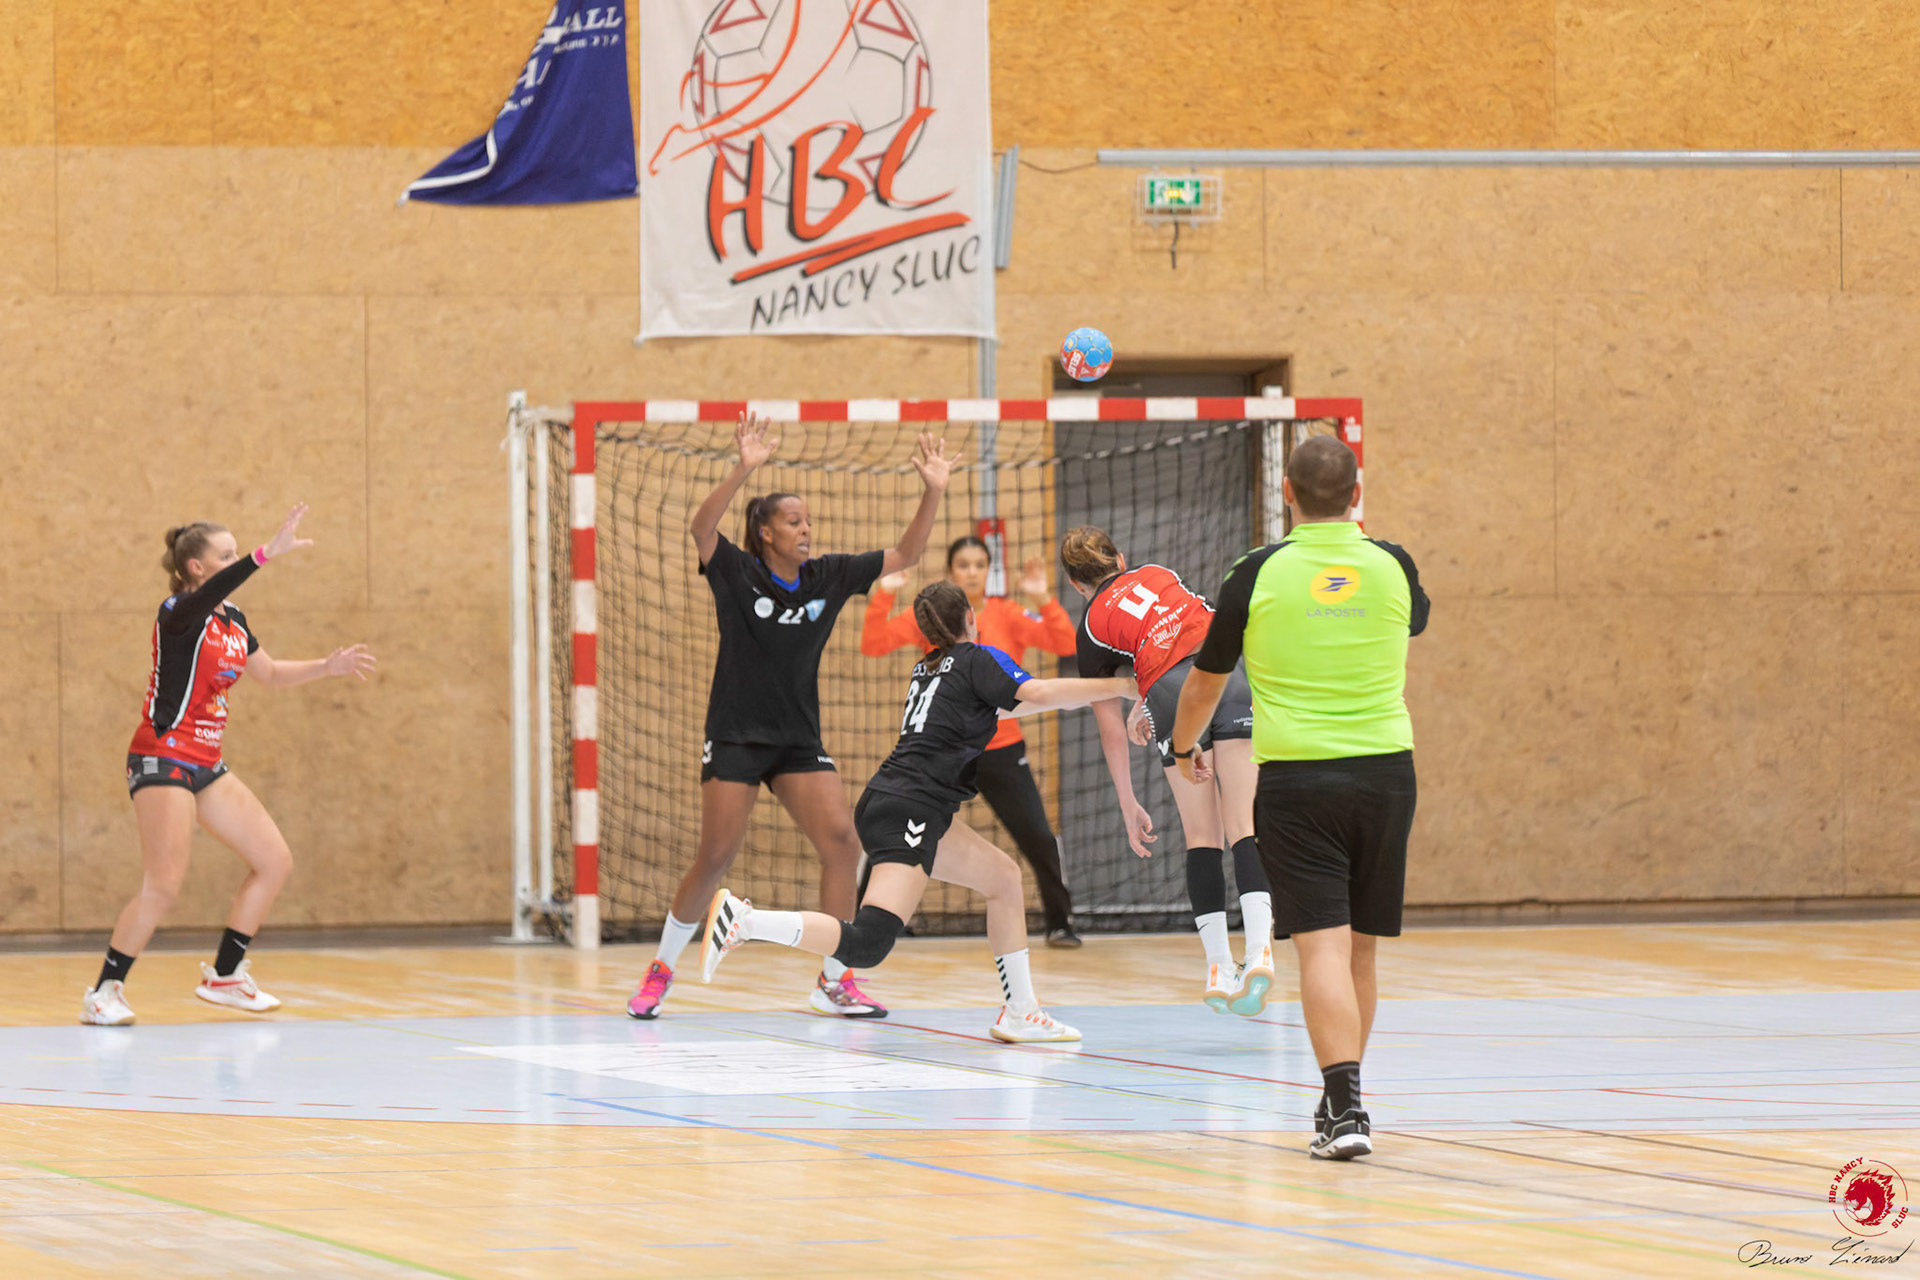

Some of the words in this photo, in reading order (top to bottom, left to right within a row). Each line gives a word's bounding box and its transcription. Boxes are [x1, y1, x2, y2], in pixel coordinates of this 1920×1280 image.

[706, 106, 957, 263] HBC
[751, 261, 879, 330] NANCY
[891, 235, 981, 295] SLUC
[778, 606, 805, 625] 22
[1117, 583, 1169, 620] 4
[1306, 608, 1322, 617] LA
[1325, 608, 1366, 617] POSTE
